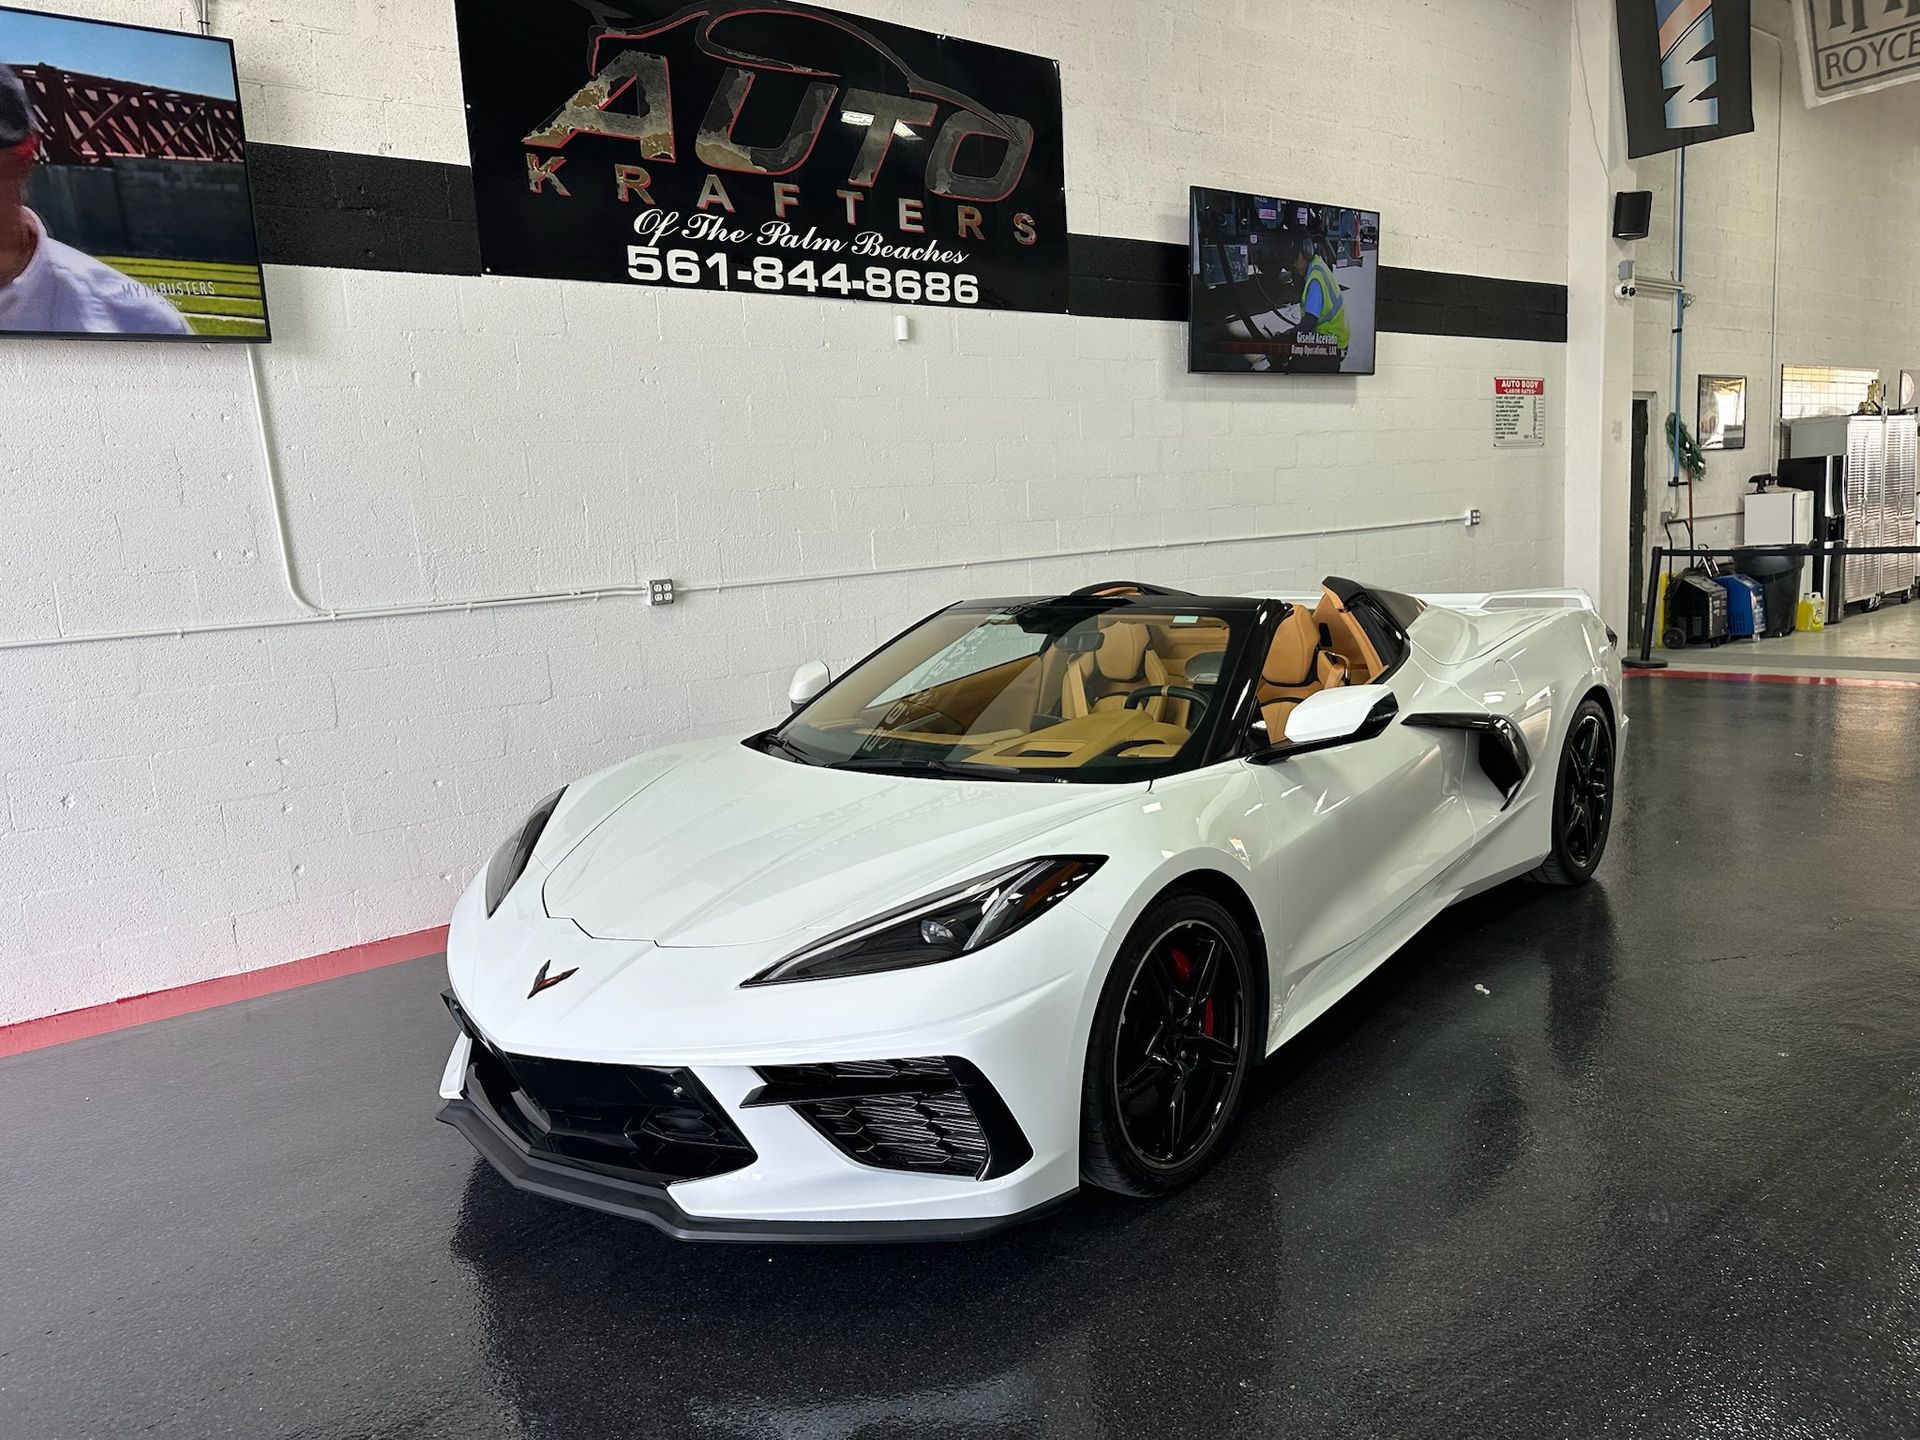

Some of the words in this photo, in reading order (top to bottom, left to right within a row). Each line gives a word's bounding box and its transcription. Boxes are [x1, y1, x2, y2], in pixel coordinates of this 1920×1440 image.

[1825, 27, 1920, 80] ROYCE
[522, 49, 1034, 201] AUTO
[525, 152, 1037, 246] KRAFTERS
[633, 209, 678, 246] Of
[682, 212, 752, 243] The
[757, 220, 848, 252] Palm
[852, 231, 969, 264] Beaches
[122, 281, 215, 298] MYTHBUSTERS
[627, 245, 979, 303] 561-844-8686
[1501, 380, 1520, 388] AUTO
[1521, 381, 1539, 389] BODY
